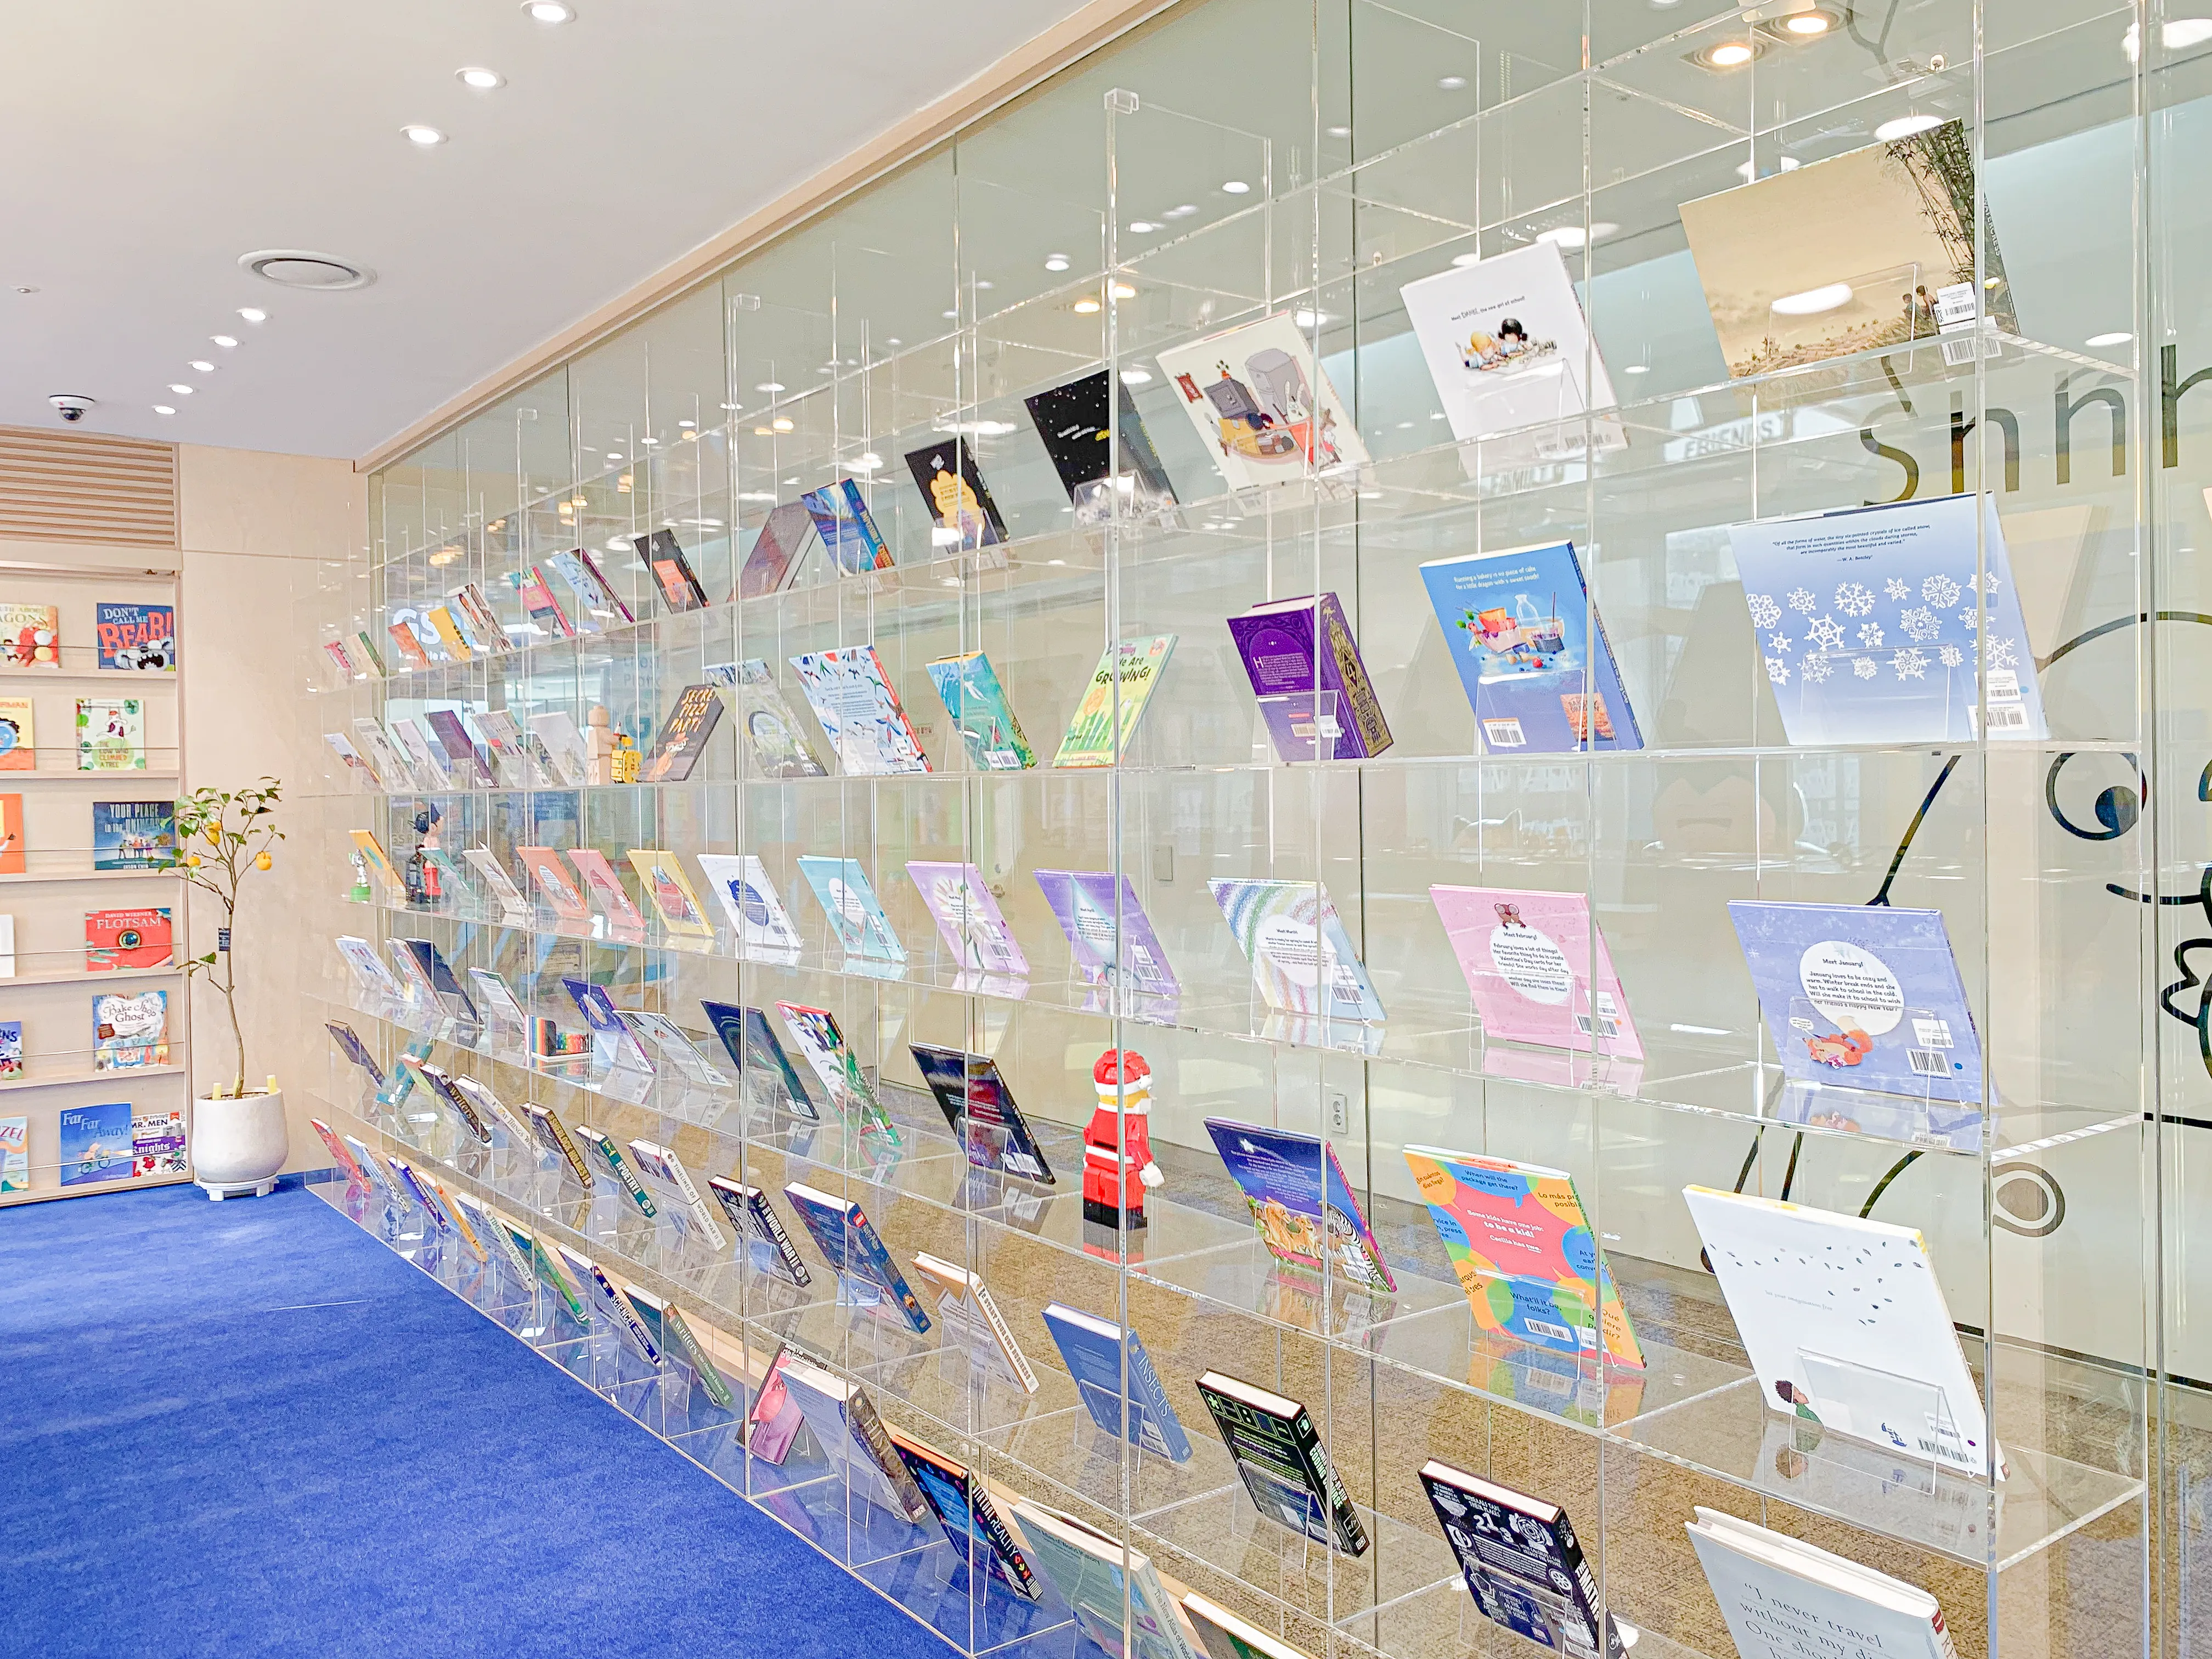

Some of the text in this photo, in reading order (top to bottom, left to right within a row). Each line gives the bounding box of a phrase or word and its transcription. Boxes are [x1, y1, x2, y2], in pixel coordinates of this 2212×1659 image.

[103, 607, 139, 620] DON'T
[1128, 657, 1144, 666] Are
[679, 702, 709, 718] PIZZA
[110, 803, 159, 819] YOUR PLACE
[96, 917, 161, 929] FLOTSAM
[104, 999, 156, 1018] Bake Shop
[115, 1013, 144, 1022] Ghost
[62, 1113, 83, 1126] Far
[81, 1118, 100, 1130] Far
[94, 1125, 128, 1139] Away!
[550, 1116, 588, 1176] SHERLOCK HOLMES
[618, 1164, 639, 1191] POETRY
[1465, 1170, 1483, 1178] When
[1462, 1176, 1486, 1185] package
[1499, 1183, 1518, 1191] there?
[673, 1164, 691, 1192] TIMELINES
[697, 1203, 709, 1223] WORLD
[708, 1222, 716, 1235] WAR
[1466, 1209, 1486, 1218] Some
[1486, 1214, 1501, 1222] kids
[1500, 1217, 1517, 1226] have
[765, 1213, 796, 1261] WORLD WAR
[1496, 1222, 1508, 1232] be
[1516, 1228, 1535, 1238] kid!
[489, 1217, 531, 1278] TIMELINES OF SCIENCE
[1513, 1239, 1526, 1248] has
[1526, 1243, 1542, 1251] two.
[1510, 1291, 1538, 1304] What'll
[1541, 1298, 1547, 1306] it
[611, 1294, 635, 1327] SCIENCE!
[1527, 1304, 1550, 1316] folks?
[1138, 1355, 1171, 1417] INSECTS
[1310, 1447, 1327, 1479] CODING
[972, 1485, 1019, 1557] VIRTUAL REALITY
[1154, 1588, 1163, 1603] The
[1160, 1602, 1171, 1618] New
[1740, 1602, 1846, 1656] without my
[1771, 1598, 1819, 1623] never
[1828, 1621, 1883, 1649] travel
[1746, 1620, 1784, 1645] One
